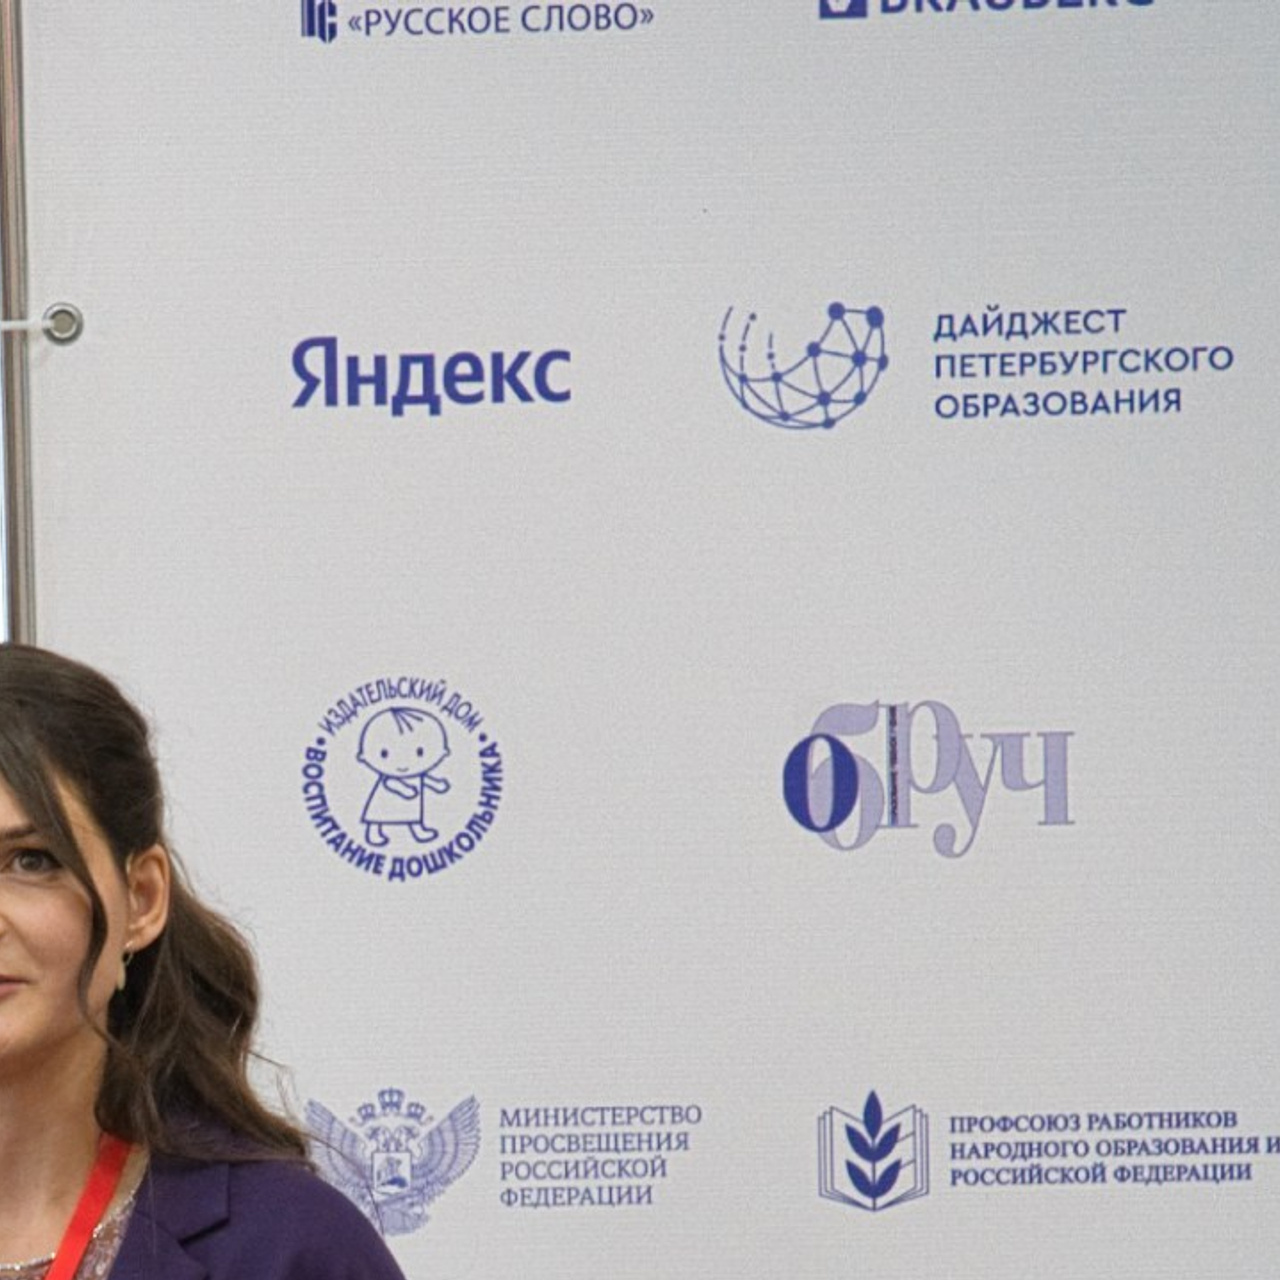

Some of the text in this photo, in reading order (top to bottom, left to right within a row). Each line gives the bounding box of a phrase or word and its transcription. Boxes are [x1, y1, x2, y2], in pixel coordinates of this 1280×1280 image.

[347, 2, 655, 37] «РУССКОЕ СЛОВО»
[933, 304, 1127, 342] ДАЙДЖЕСТ
[291, 336, 571, 417] Яндекс
[935, 346, 1235, 379] ПЕТЕРБУРГСКОГО
[934, 388, 1182, 419] ОБРАЗОВАНИЯ
[318, 676, 484, 737] ИЗДАТЕЛЬСКИЙ ДОМ
[302, 742, 504, 882] ВОСПИТАНИЕ ДОШКОЛЬНИКА
[499, 1105, 703, 1128] МИНИСТЕРСТВО
[949, 1110, 1238, 1134] ПРОФСОЮЗ РАБОТНИКОВ
[500, 1131, 691, 1155] ПРОСВЕЩЕНИЯ
[950, 1139, 1090, 1161] НАРОДНОГО
[1095, 1136, 1259, 1158] ОБРАЗОВАНИЯ
[500, 1155, 668, 1182] РОССИЙСКОЙ
[950, 1162, 1253, 1187] РОССИЙСКОЙ ФЕДЕРАЦИИ
[500, 1185, 654, 1209] ФЕДЕРАЦИИ
